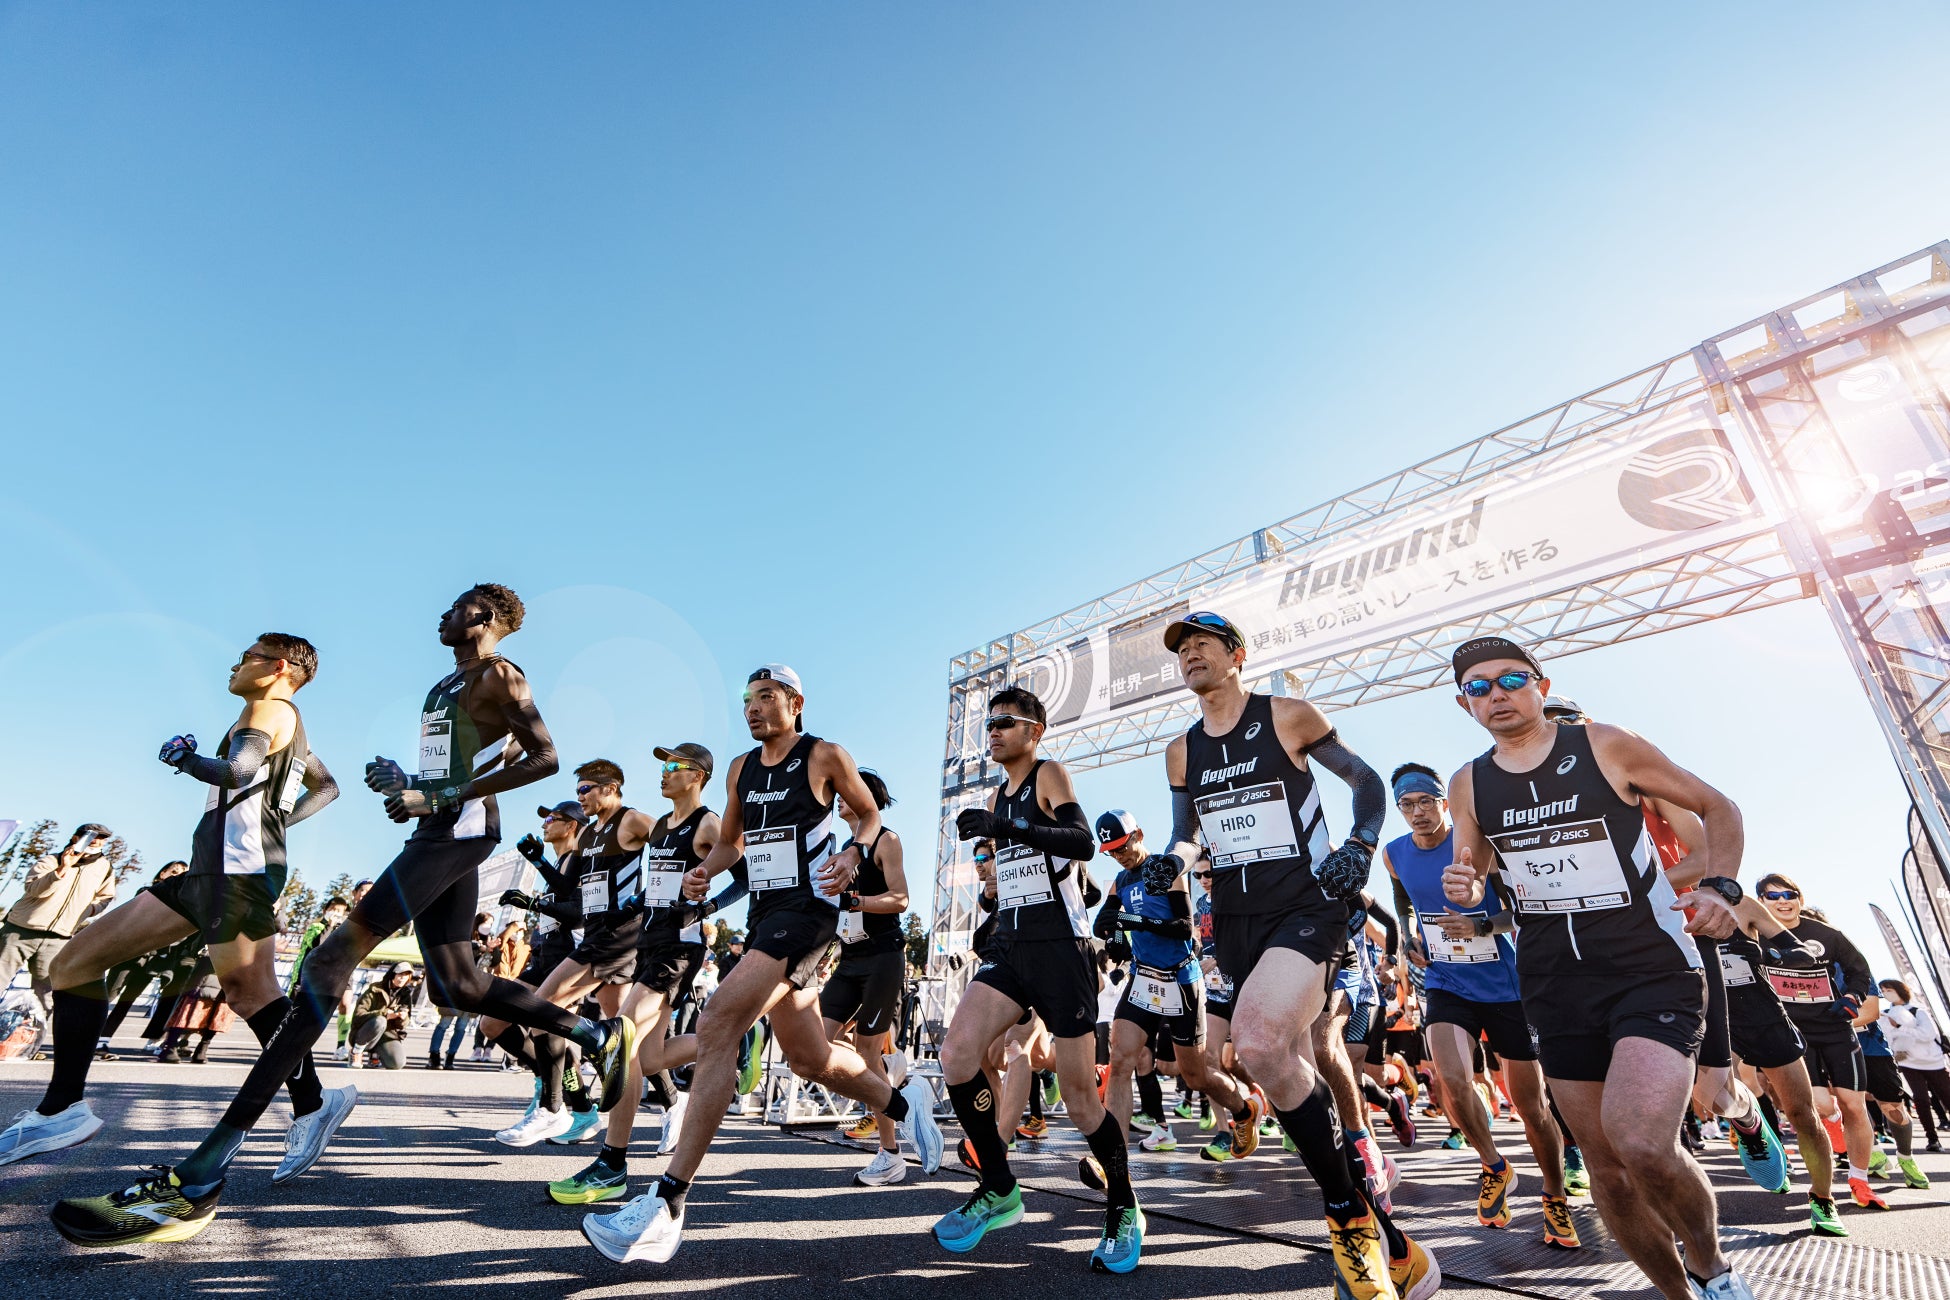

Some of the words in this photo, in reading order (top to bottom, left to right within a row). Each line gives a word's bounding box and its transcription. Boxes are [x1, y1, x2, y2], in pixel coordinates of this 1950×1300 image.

[1277, 496, 1488, 609] Beyond
[1099, 661, 1183, 699] #世界一自
[1251, 538, 1560, 654] 更新率の高いレースを作る
[1455, 641, 1509, 657] SALOMON
[1200, 756, 1259, 785] Beyond
[746, 788, 790, 805] Beyond
[1208, 796, 1235, 809] Beyond
[1503, 794, 1580, 828] Beyond
[1220, 814, 1256, 832] HIRO
[1509, 835, 1541, 848] Beyond
[749, 853, 772, 866] yama
